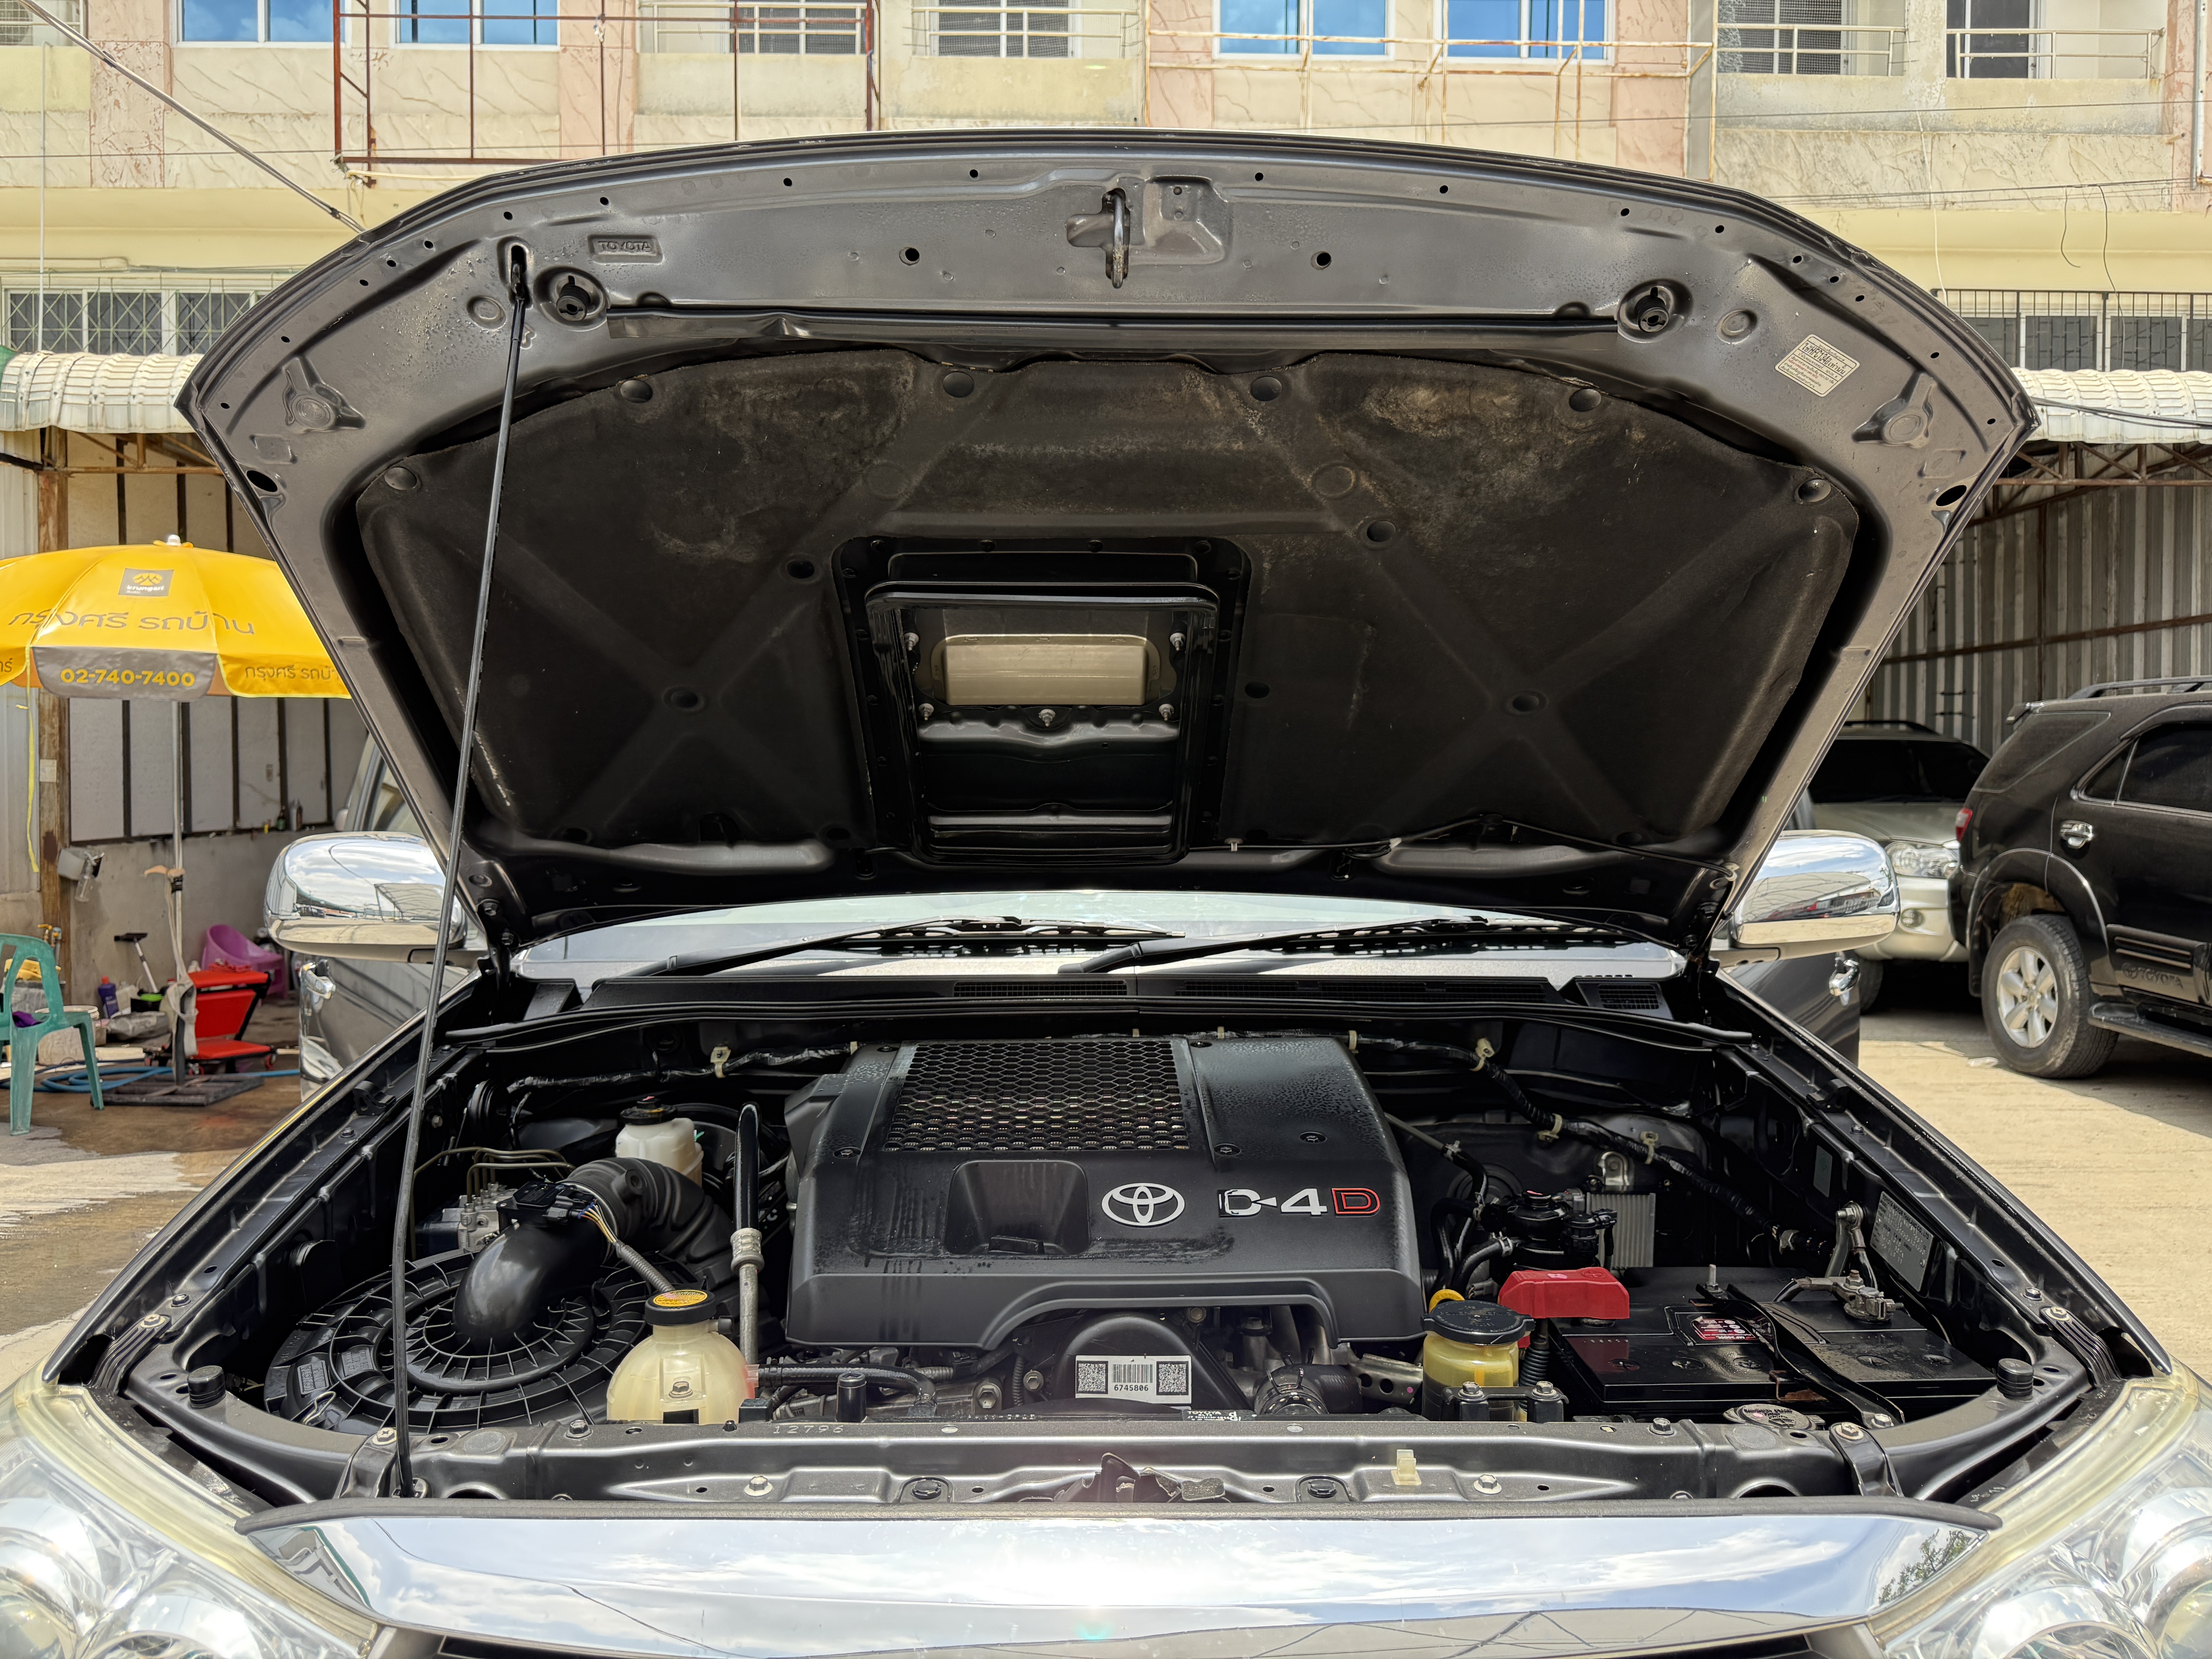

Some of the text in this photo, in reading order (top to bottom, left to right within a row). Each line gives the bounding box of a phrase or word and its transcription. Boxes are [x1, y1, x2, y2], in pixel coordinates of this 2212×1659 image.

[598, 241, 653, 252] TOYOTA
[60, 668, 195, 687] 02-740-7400
[245, 664, 296, 681] กรุงศรี
[773, 1425, 844, 1434] 12796
